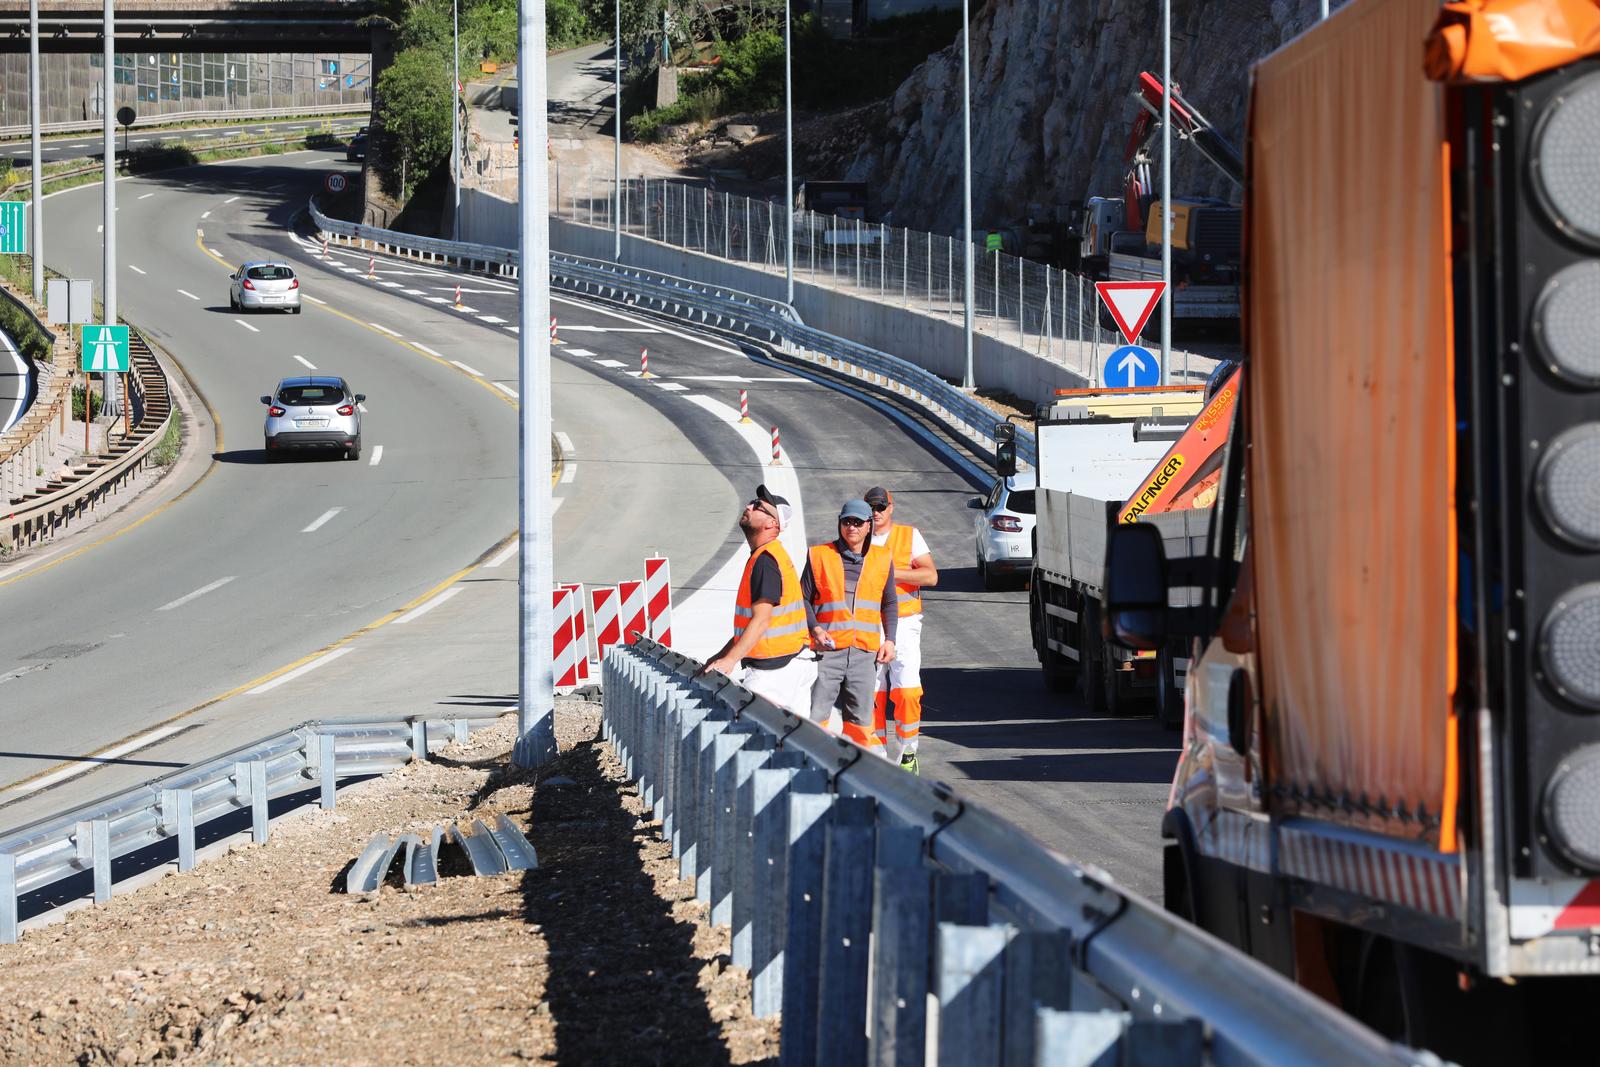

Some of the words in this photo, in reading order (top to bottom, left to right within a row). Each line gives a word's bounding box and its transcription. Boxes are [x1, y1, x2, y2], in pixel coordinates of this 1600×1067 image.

[330, 177, 344, 188] 100
[1194, 417, 1208, 431] PK
[1206, 389, 1231, 418] 15500
[1124, 458, 1182, 524] PALFINGER
[1010, 544, 1020, 552] HR
